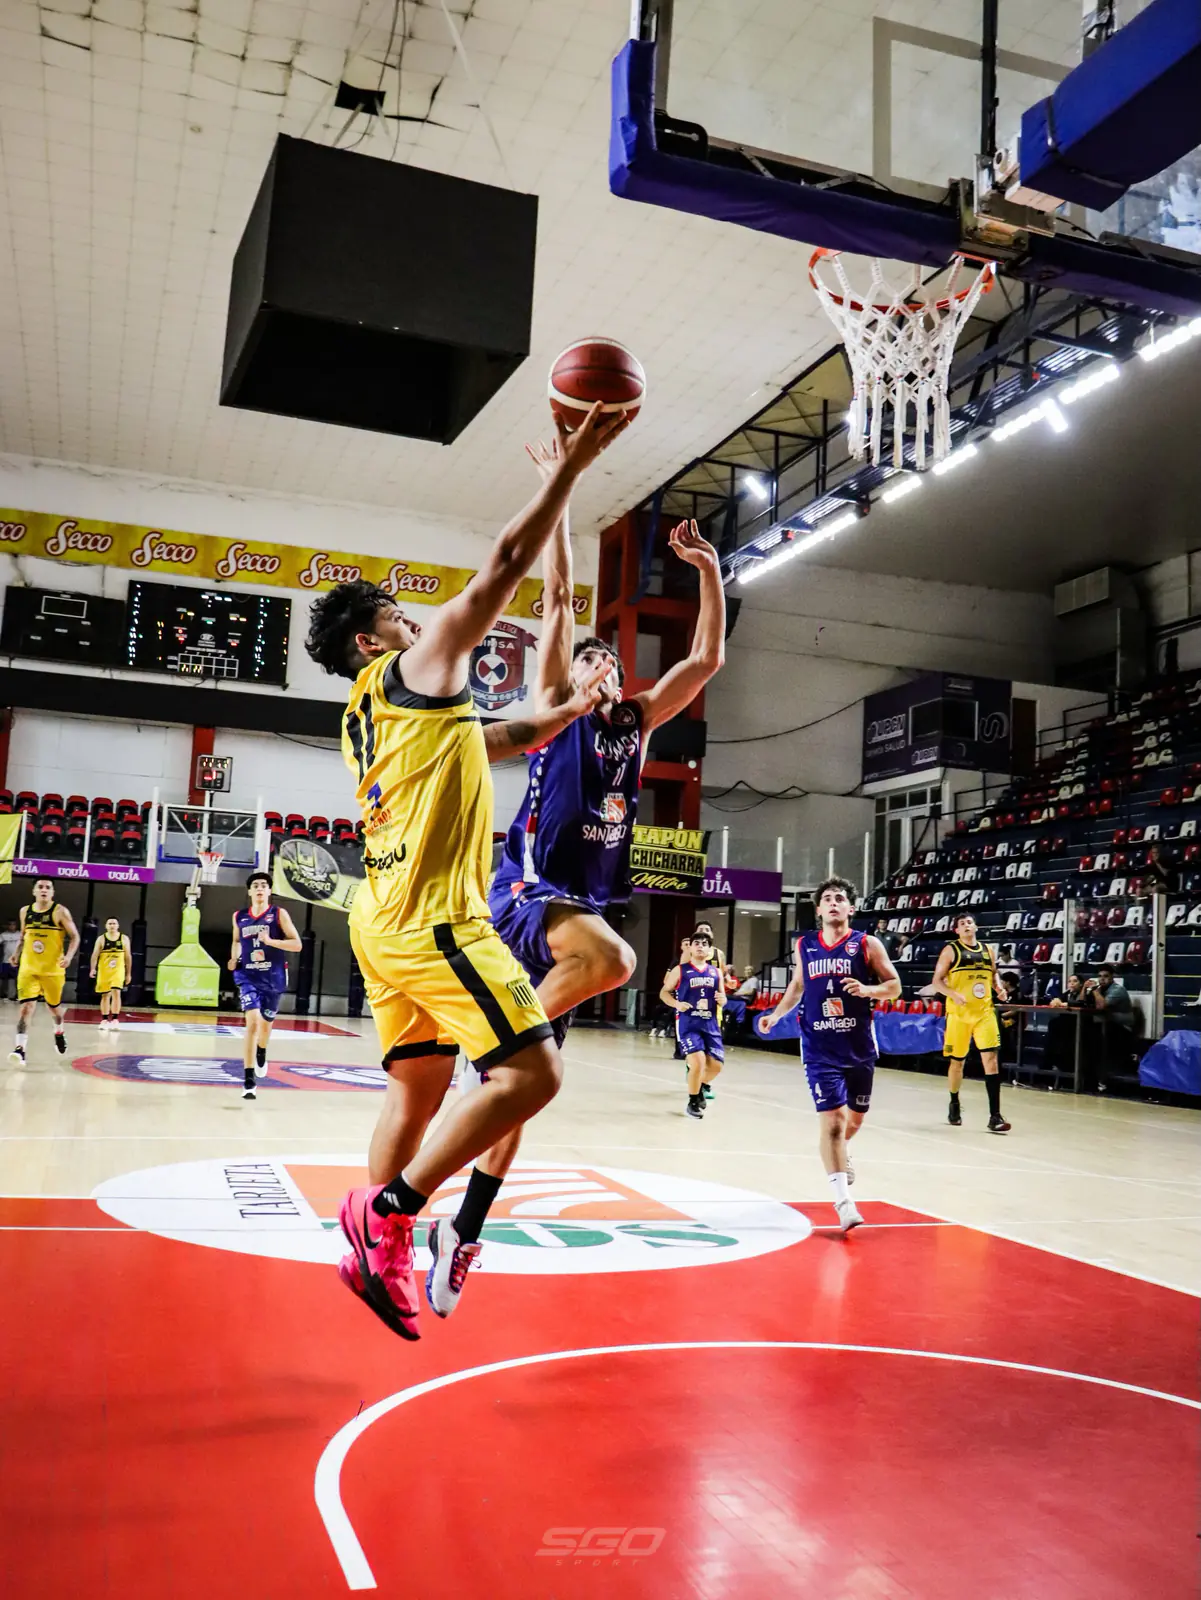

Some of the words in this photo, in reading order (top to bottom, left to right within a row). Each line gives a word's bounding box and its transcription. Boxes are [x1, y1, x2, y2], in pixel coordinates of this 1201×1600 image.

[45, 520, 113, 556] Secco
[131, 531, 196, 567] Secco
[216, 543, 281, 577] Secco
[299, 553, 361, 587] Secco
[380, 563, 440, 597] Secco
[631, 848, 705, 874] CHICHARRA
[630, 872, 689, 890] Mitre
[808, 958, 852, 979] QUIMSA
[700, 988, 706, 997] 5
[826, 979, 834, 994] 4
[223, 1163, 301, 1219] TARJETA
